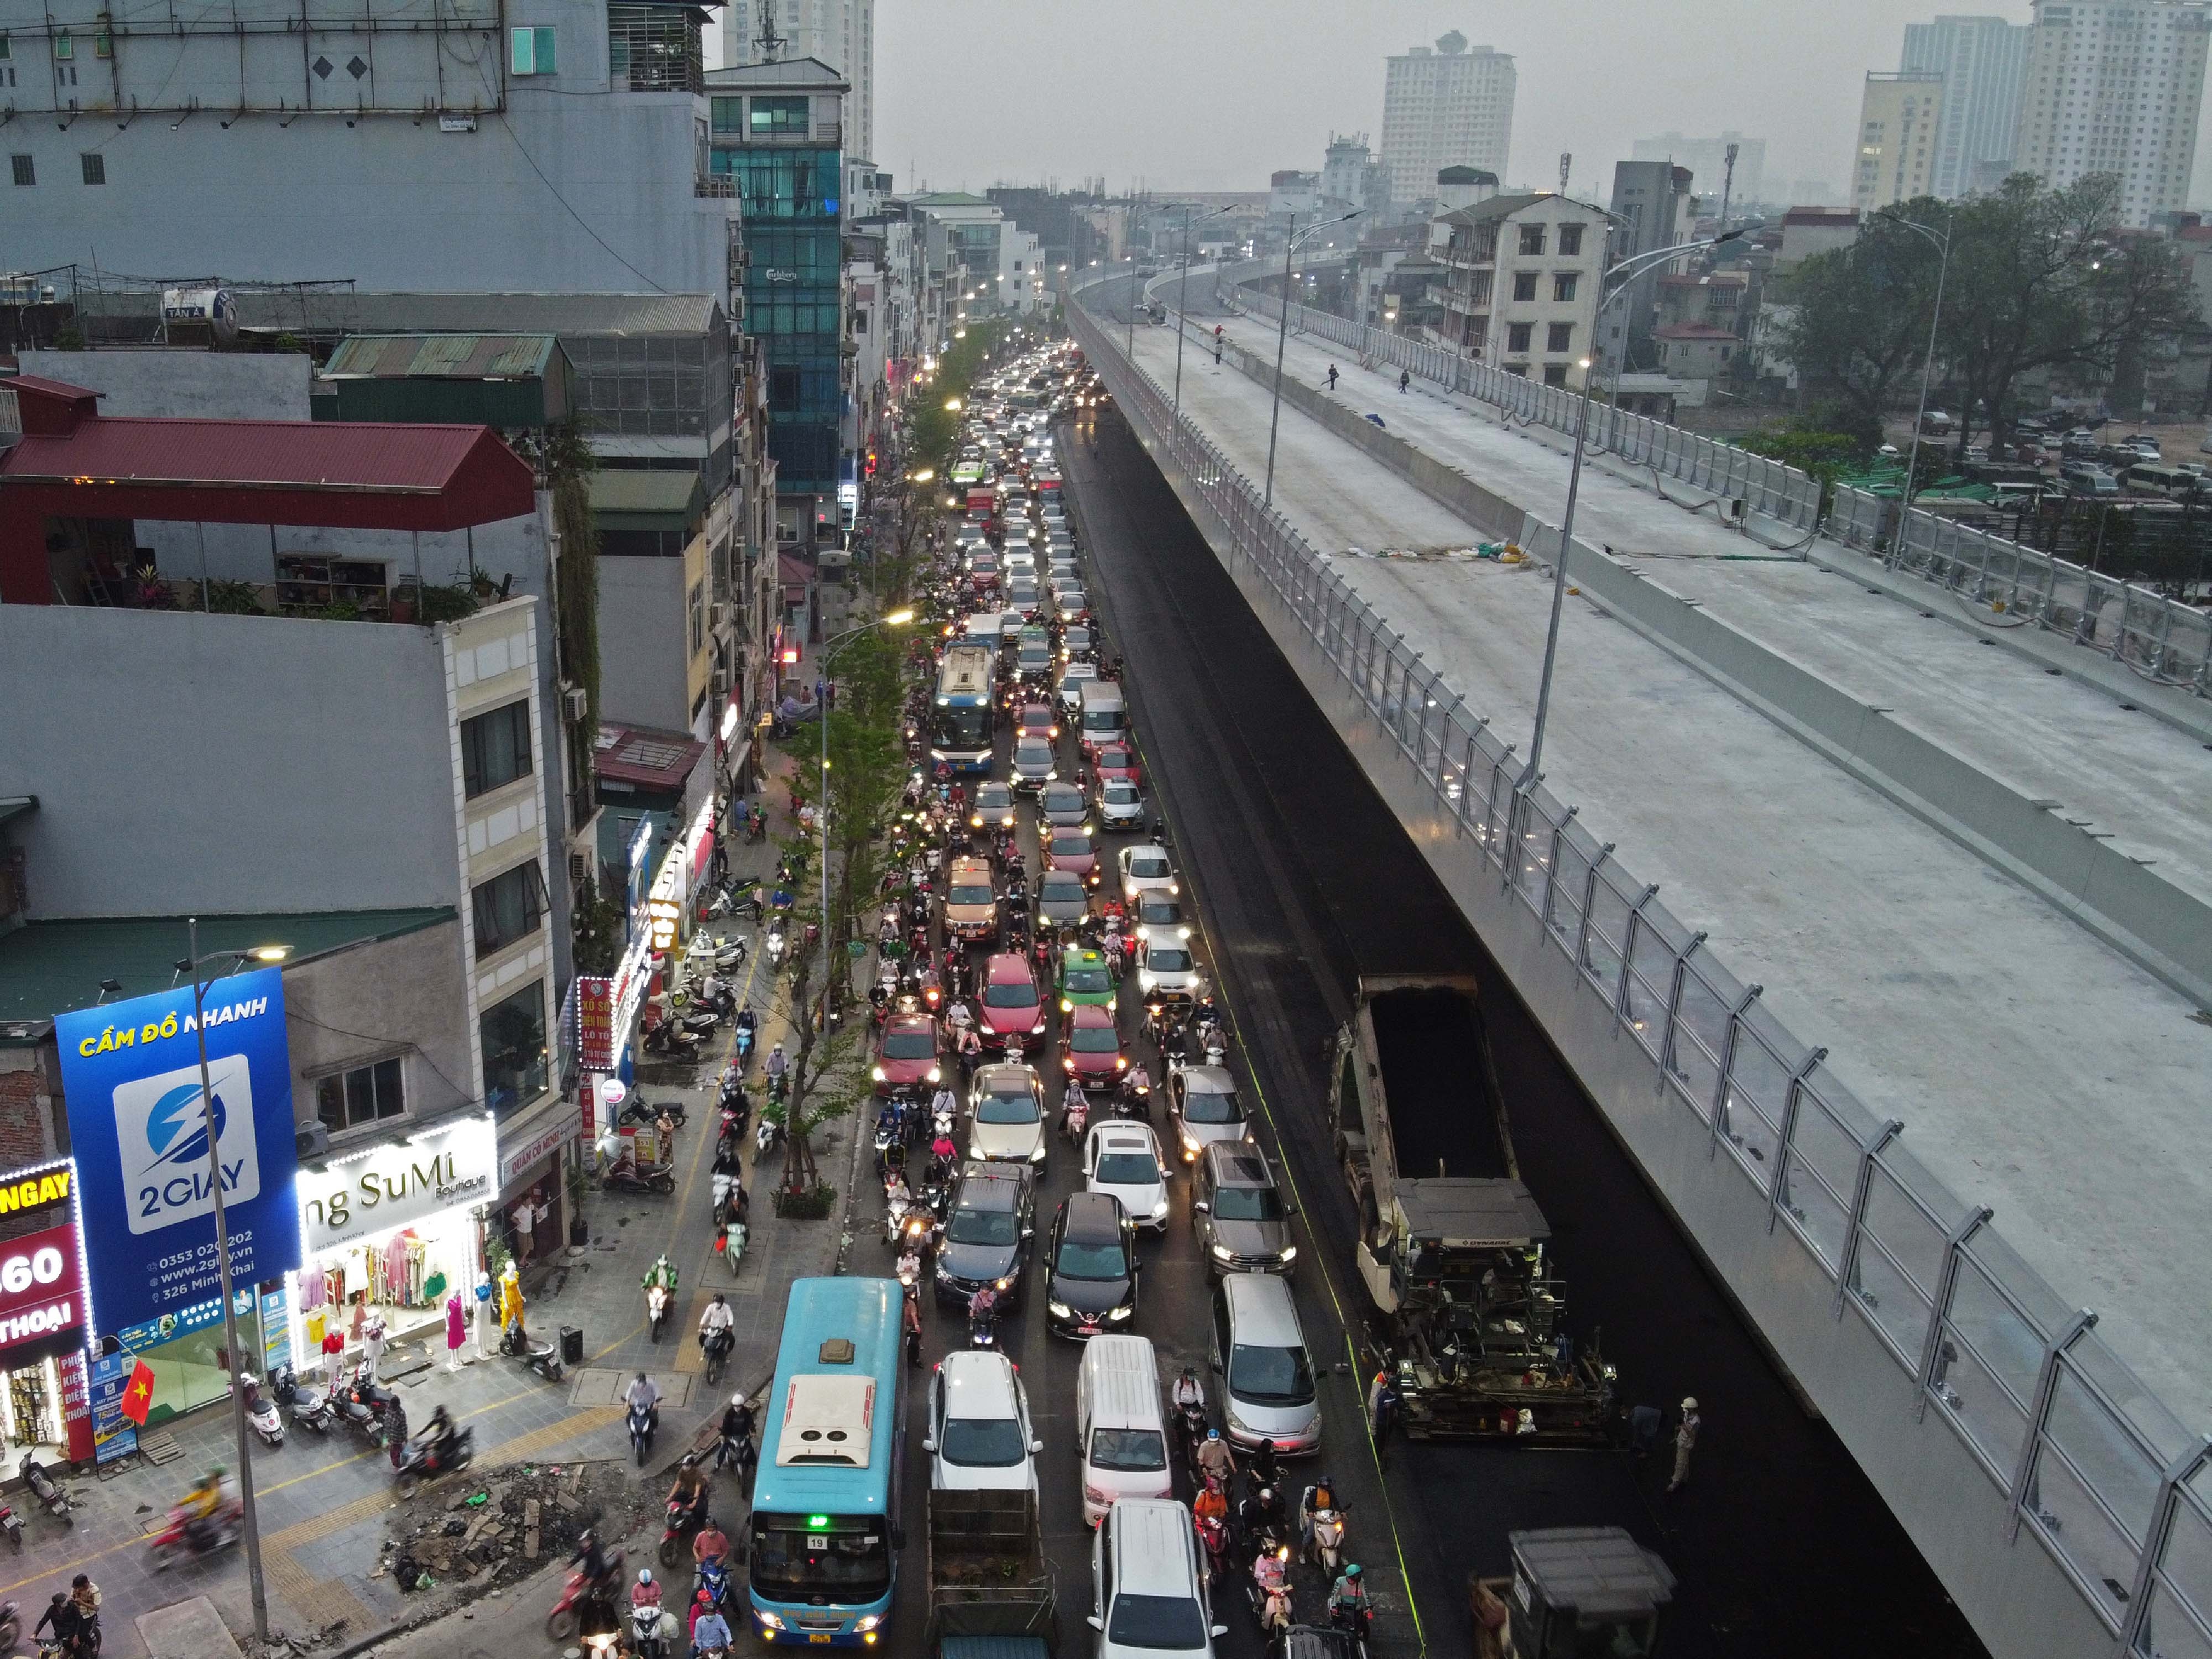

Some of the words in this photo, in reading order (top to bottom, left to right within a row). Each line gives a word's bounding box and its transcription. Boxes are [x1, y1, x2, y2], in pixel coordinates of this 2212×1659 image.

[184, 997, 267, 1033] NHANH
[0, 1172, 70, 1213] NGAY
[436, 1174, 486, 1198] Boutique
[159, 1250, 193, 1269] 0353
[227, 1230, 253, 1247] 202
[161, 1246, 253, 1283] www.2giy.vn
[0, 1248, 62, 1293] 60
[163, 1284, 187, 1300] 326
[192, 1272, 222, 1291] Minh
[811, 1539, 823, 1548] 19
